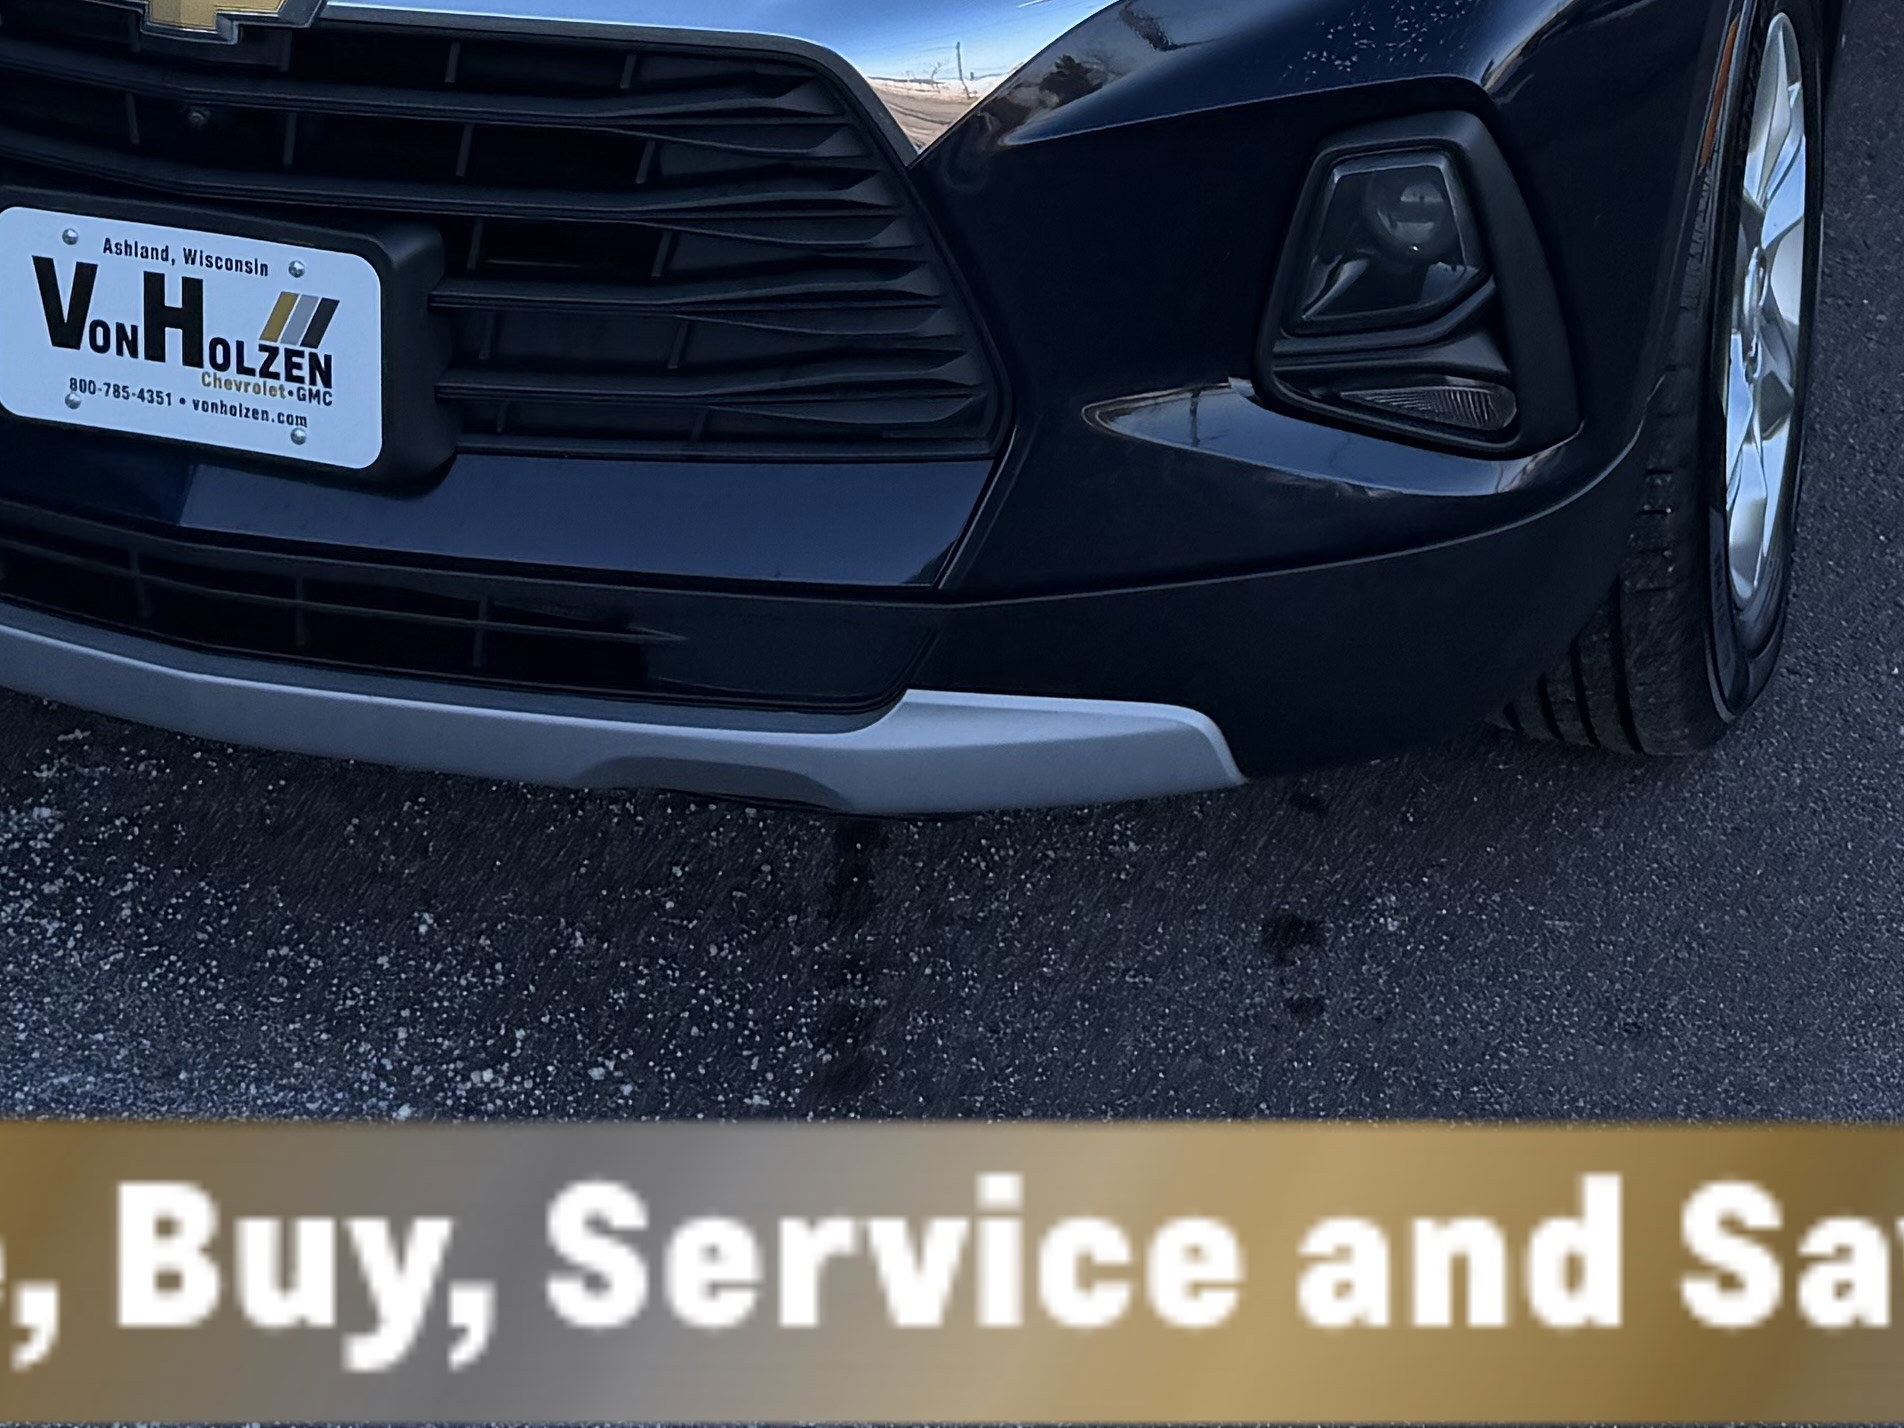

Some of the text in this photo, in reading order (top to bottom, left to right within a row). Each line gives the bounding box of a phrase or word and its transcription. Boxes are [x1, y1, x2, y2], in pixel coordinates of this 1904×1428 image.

[103, 237, 269, 277] Ashland, Wisconsin
[69, 377, 308, 428] 800-785-4351 vonholzen.com
